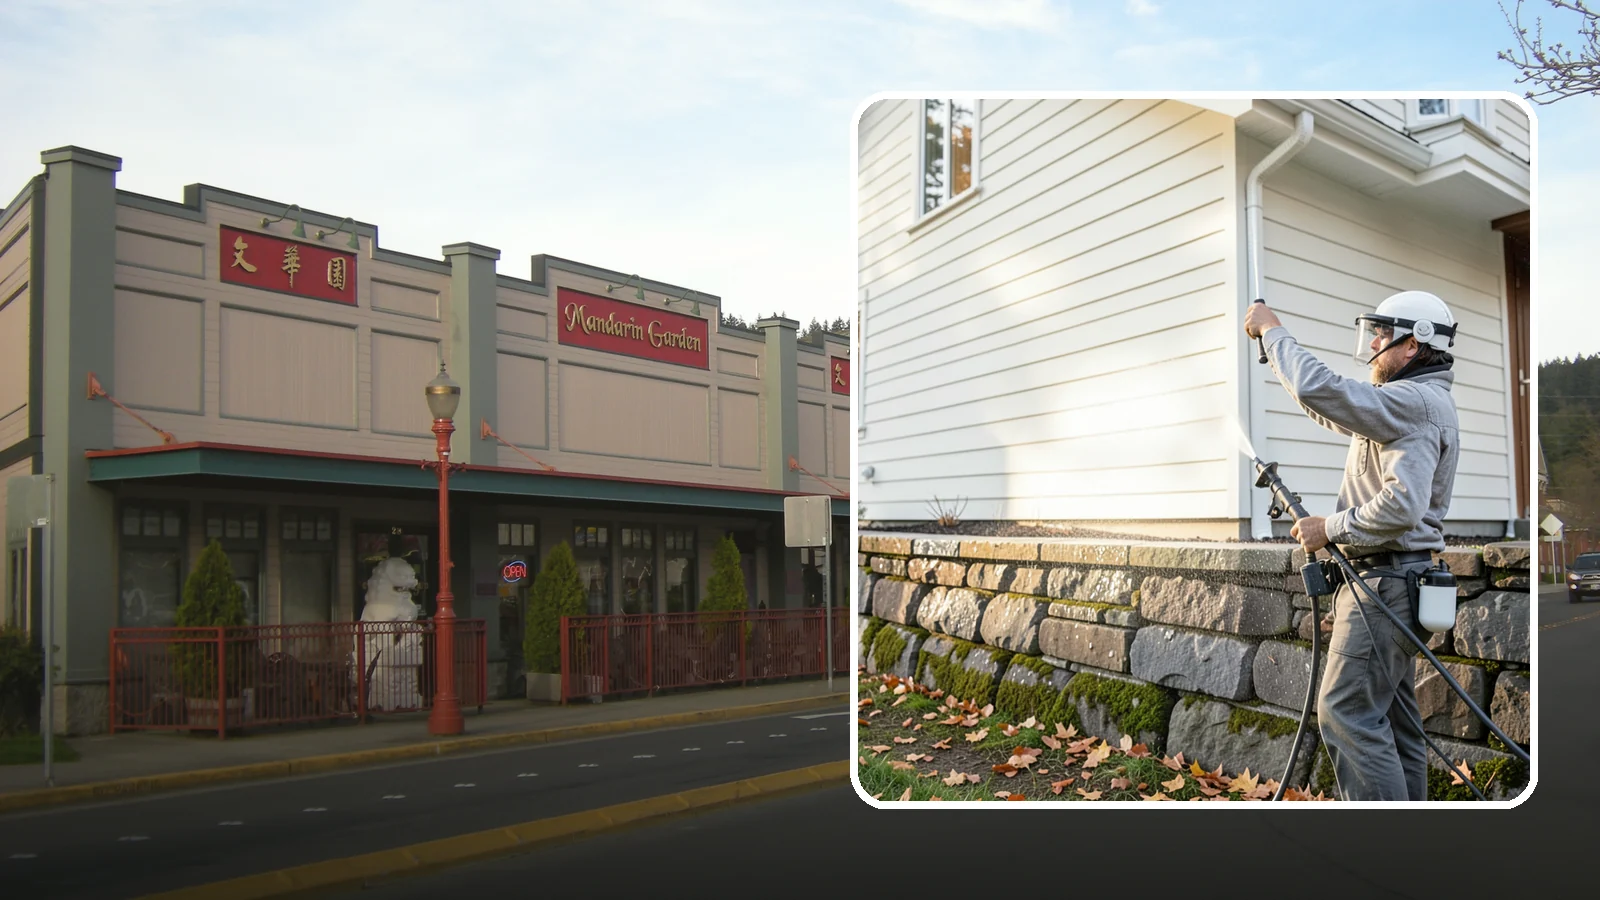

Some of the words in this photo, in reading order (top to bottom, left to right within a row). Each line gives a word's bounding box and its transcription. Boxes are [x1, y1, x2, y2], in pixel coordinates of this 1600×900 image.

[231, 235, 346, 291] 文華園
[564, 302, 644, 341] Mandarin
[648, 320, 702, 352] Garden
[503, 565, 527, 578] OPEN
